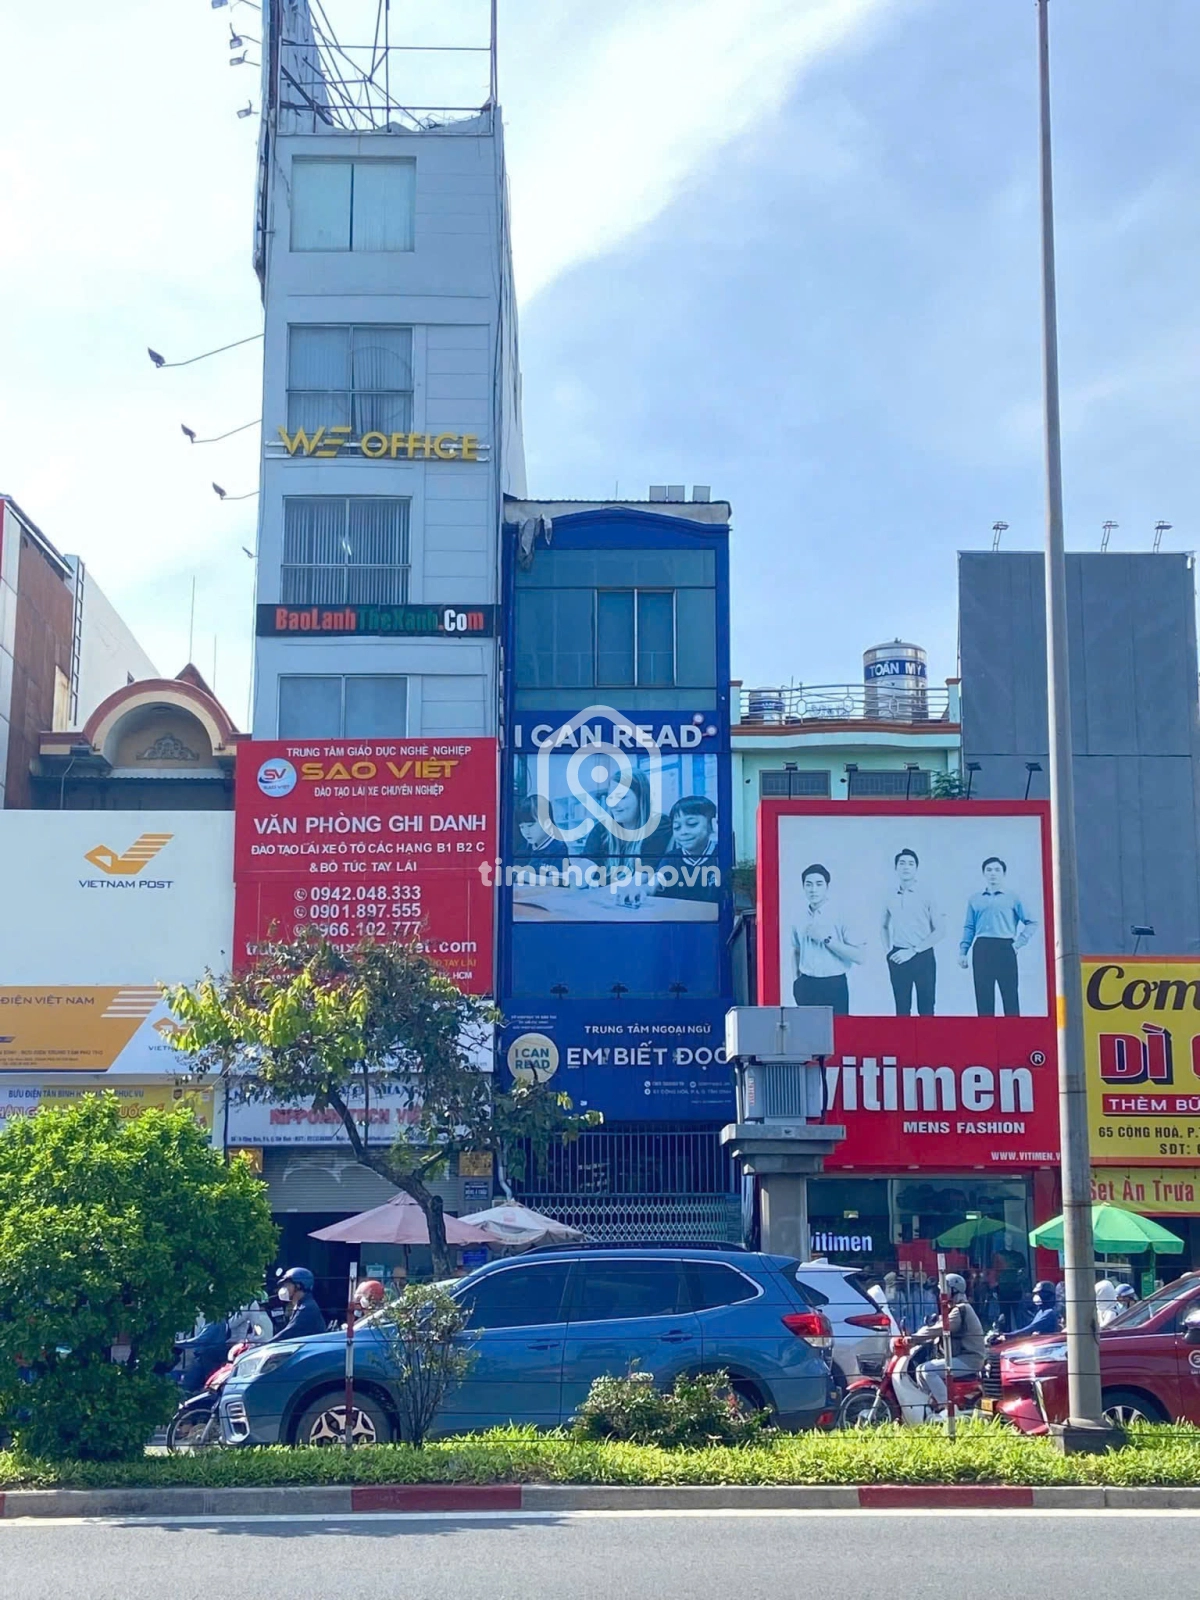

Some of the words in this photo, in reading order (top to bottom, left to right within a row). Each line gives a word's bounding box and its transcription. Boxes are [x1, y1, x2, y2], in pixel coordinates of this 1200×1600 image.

[278, 425, 352, 456] WE
[361, 432, 478, 460] OFFICE
[514, 726, 522, 748] I
[531, 725, 602, 748] CAN
[613, 725, 702, 748] READ
[286, 747, 321, 757] TRUNG
[347, 745, 372, 756] GIÁO
[375, 747, 397, 757] DỤC
[264, 768, 286, 780] SV
[301, 761, 377, 781] SAO
[386, 757, 459, 781] VIỆT
[334, 786, 350, 799] TẠO
[368, 786, 379, 796] XE
[381, 783, 413, 796] CHUYÊN
[415, 783, 444, 797] NGHIỆP
[253, 814, 297, 834] VĂN
[305, 812, 382, 833] PHÒNG
[388, 815, 423, 832] GHI
[430, 815, 486, 832] DANH
[251, 843, 276, 855] ĐÀO
[277, 844, 299, 856] TẠO
[322, 844, 337, 854] XE
[368, 841, 394, 853] CÁC
[396, 843, 433, 855] HẠNG
[437, 842, 452, 853] B1
[456, 842, 473, 853] B2
[476, 842, 485, 852] C
[343, 860, 367, 872] TÚC
[371, 862, 392, 872] TAY
[79, 880, 135, 888] VIETNAM
[139, 880, 174, 888] POST
[310, 885, 421, 901] 0942.048.333
[310, 903, 421, 918] 0901.897.555
[452, 971, 473, 980] HCM
[66, 996, 95, 1005] NAM
[584, 1025, 624, 1034] TRUNG
[627, 1022, 650, 1034] TÂM
[652, 1025, 686, 1036] NGOẠI
[521, 1048, 550, 1058] CAN
[567, 1048, 601, 1066] EM
[614, 1041, 668, 1066] BIẾT
[1099, 1021, 1172, 1084] DÌ
[515, 1060, 551, 1070] READ
[903, 1121, 950, 1133] MENS
[956, 1121, 1026, 1134] FASHION
[1098, 1126, 1113, 1138] 65
[1118, 1124, 1151, 1140] CỘNG
[1187, 1126, 1200, 1138] P.
[1152, 1178, 1194, 1202] Trưa
